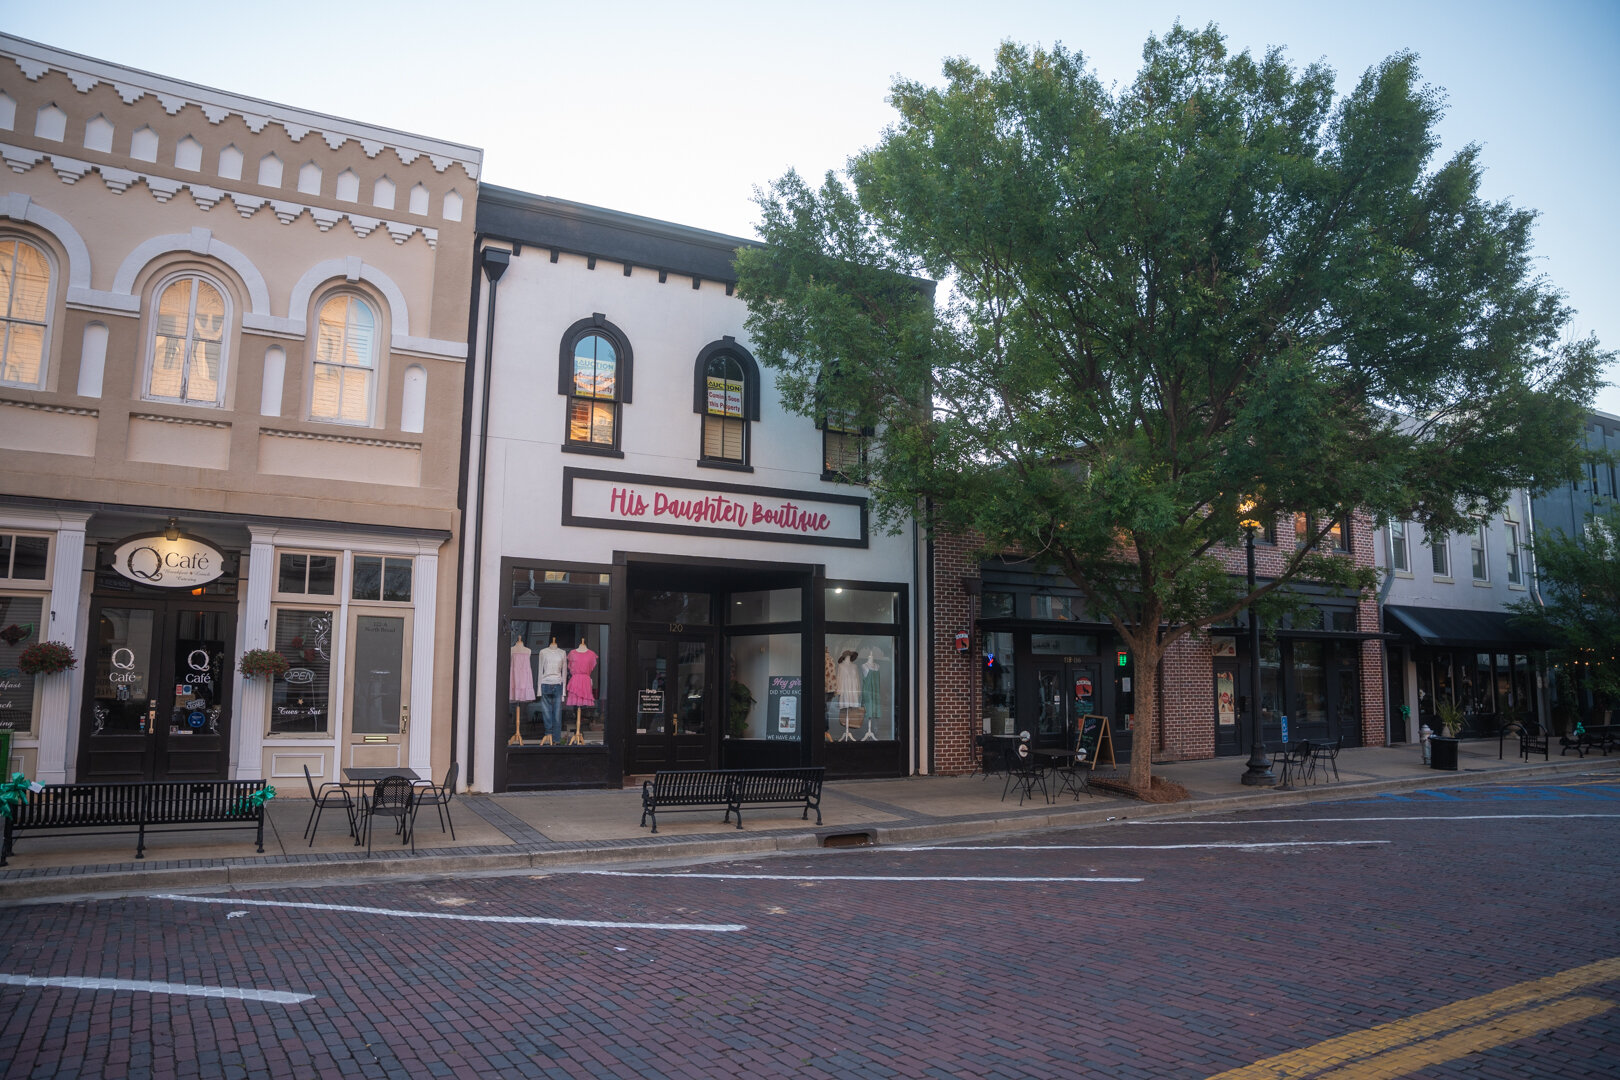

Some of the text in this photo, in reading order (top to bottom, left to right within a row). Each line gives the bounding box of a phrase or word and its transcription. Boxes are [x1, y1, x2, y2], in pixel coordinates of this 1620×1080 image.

[610, 487, 831, 532] His Daughter Boutique
[127, 546, 210, 582] Q Café
[669, 623, 684, 633] 120
[111, 647, 136, 671] Q
[187, 649, 210, 672] Q
[109, 672, 136, 682] Café
[185, 673, 211, 684] Café
[284, 671, 313, 681] OPEN
[772, 677, 789, 689] Hey
[277, 706, 299, 715] Tues
[307, 706, 321, 715] Sat
